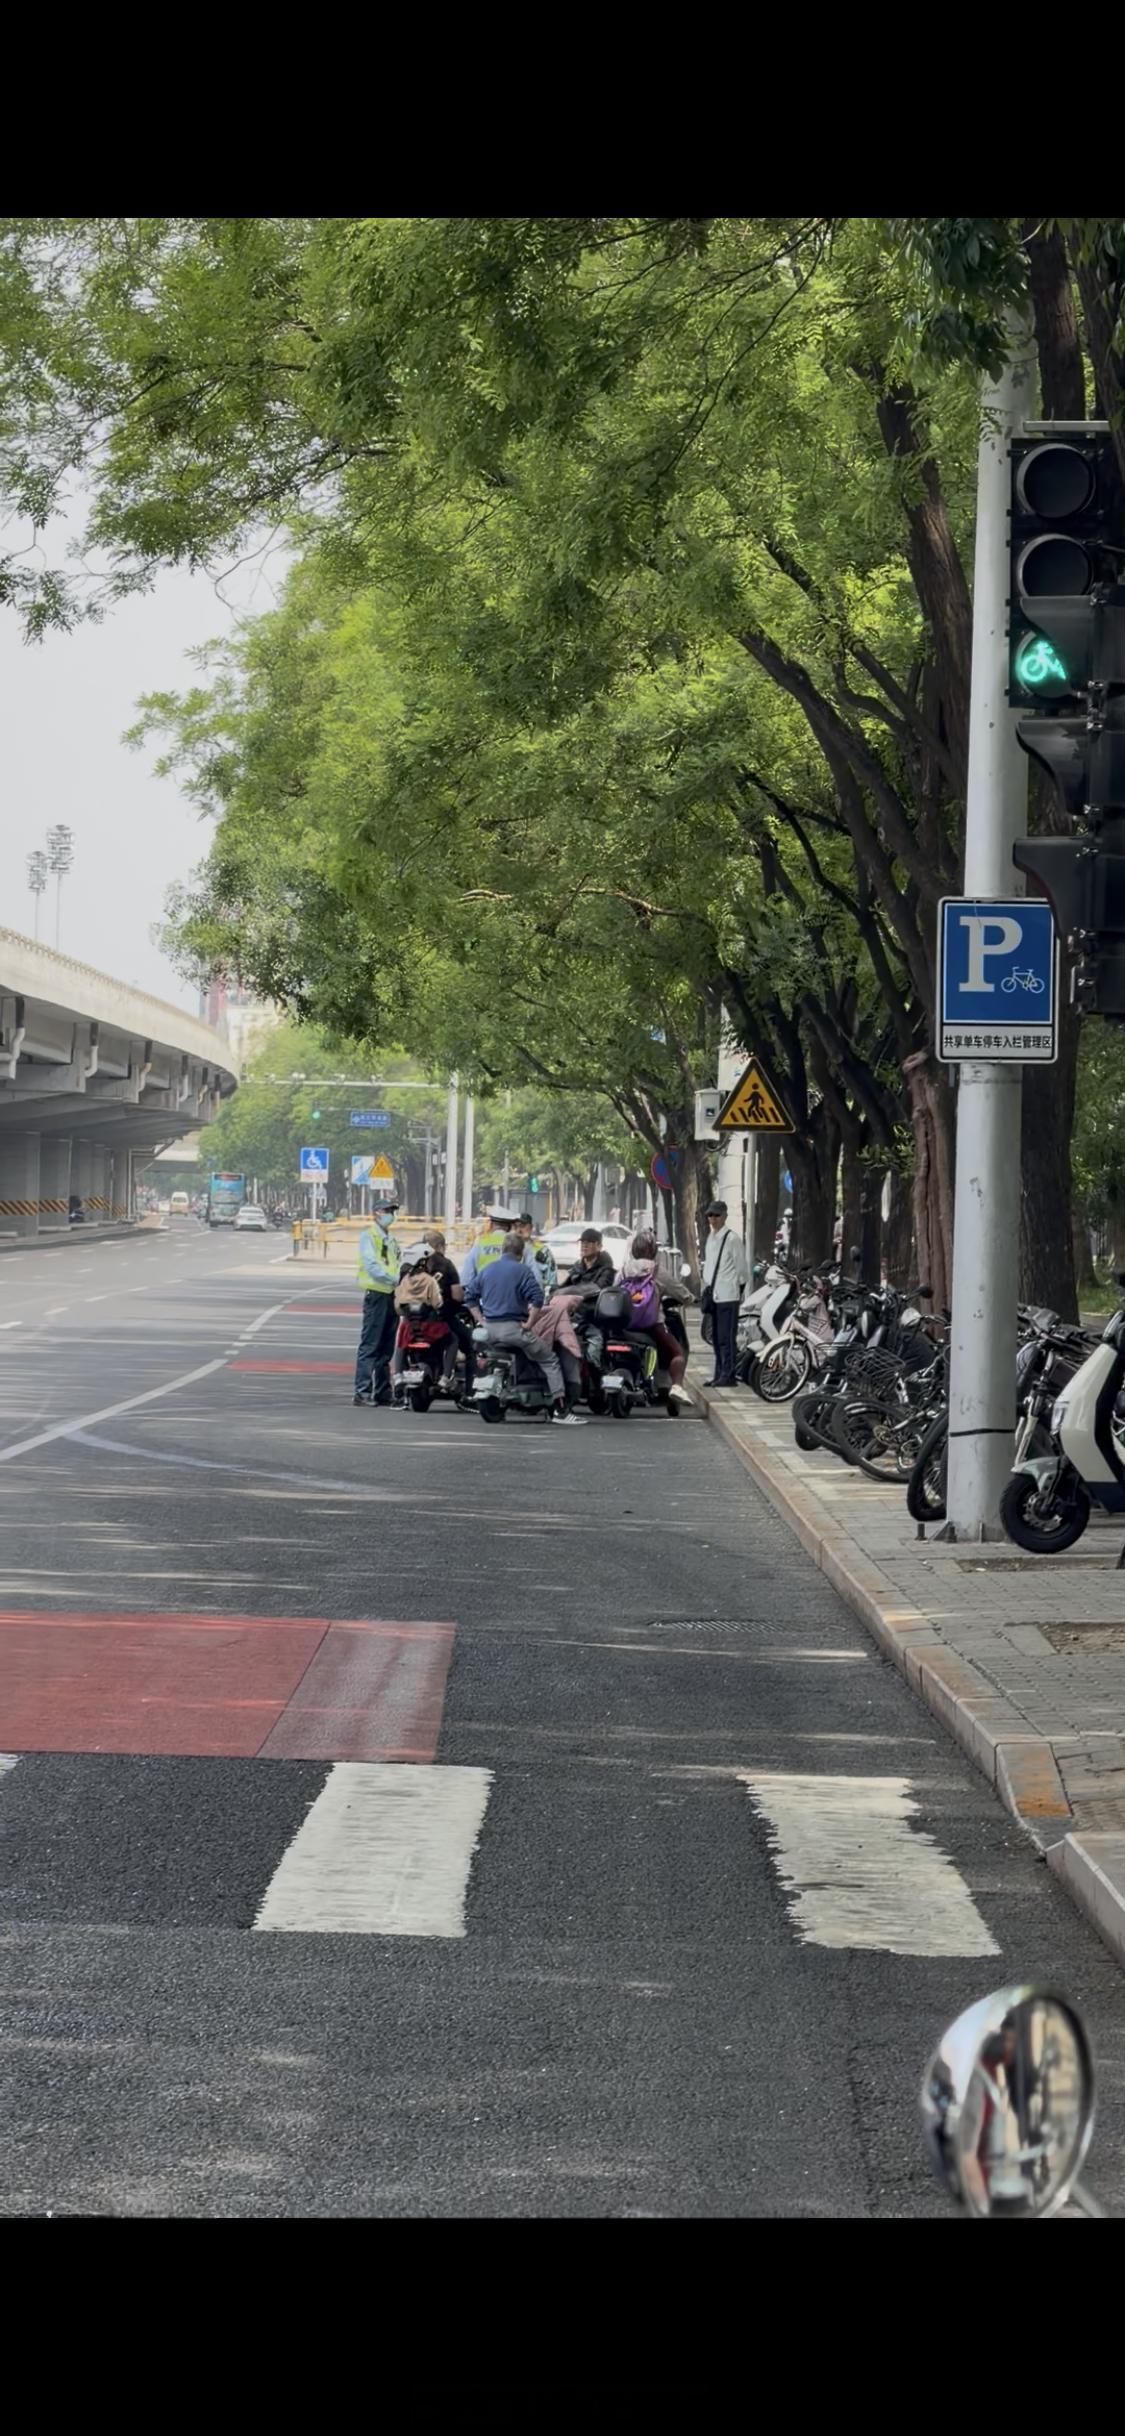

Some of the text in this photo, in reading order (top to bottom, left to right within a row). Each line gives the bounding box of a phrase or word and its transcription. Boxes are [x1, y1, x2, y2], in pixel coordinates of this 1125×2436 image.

[958, 915, 1023, 993] P
[944, 1034, 1051, 1049] 共享单车停车入栏管理区
